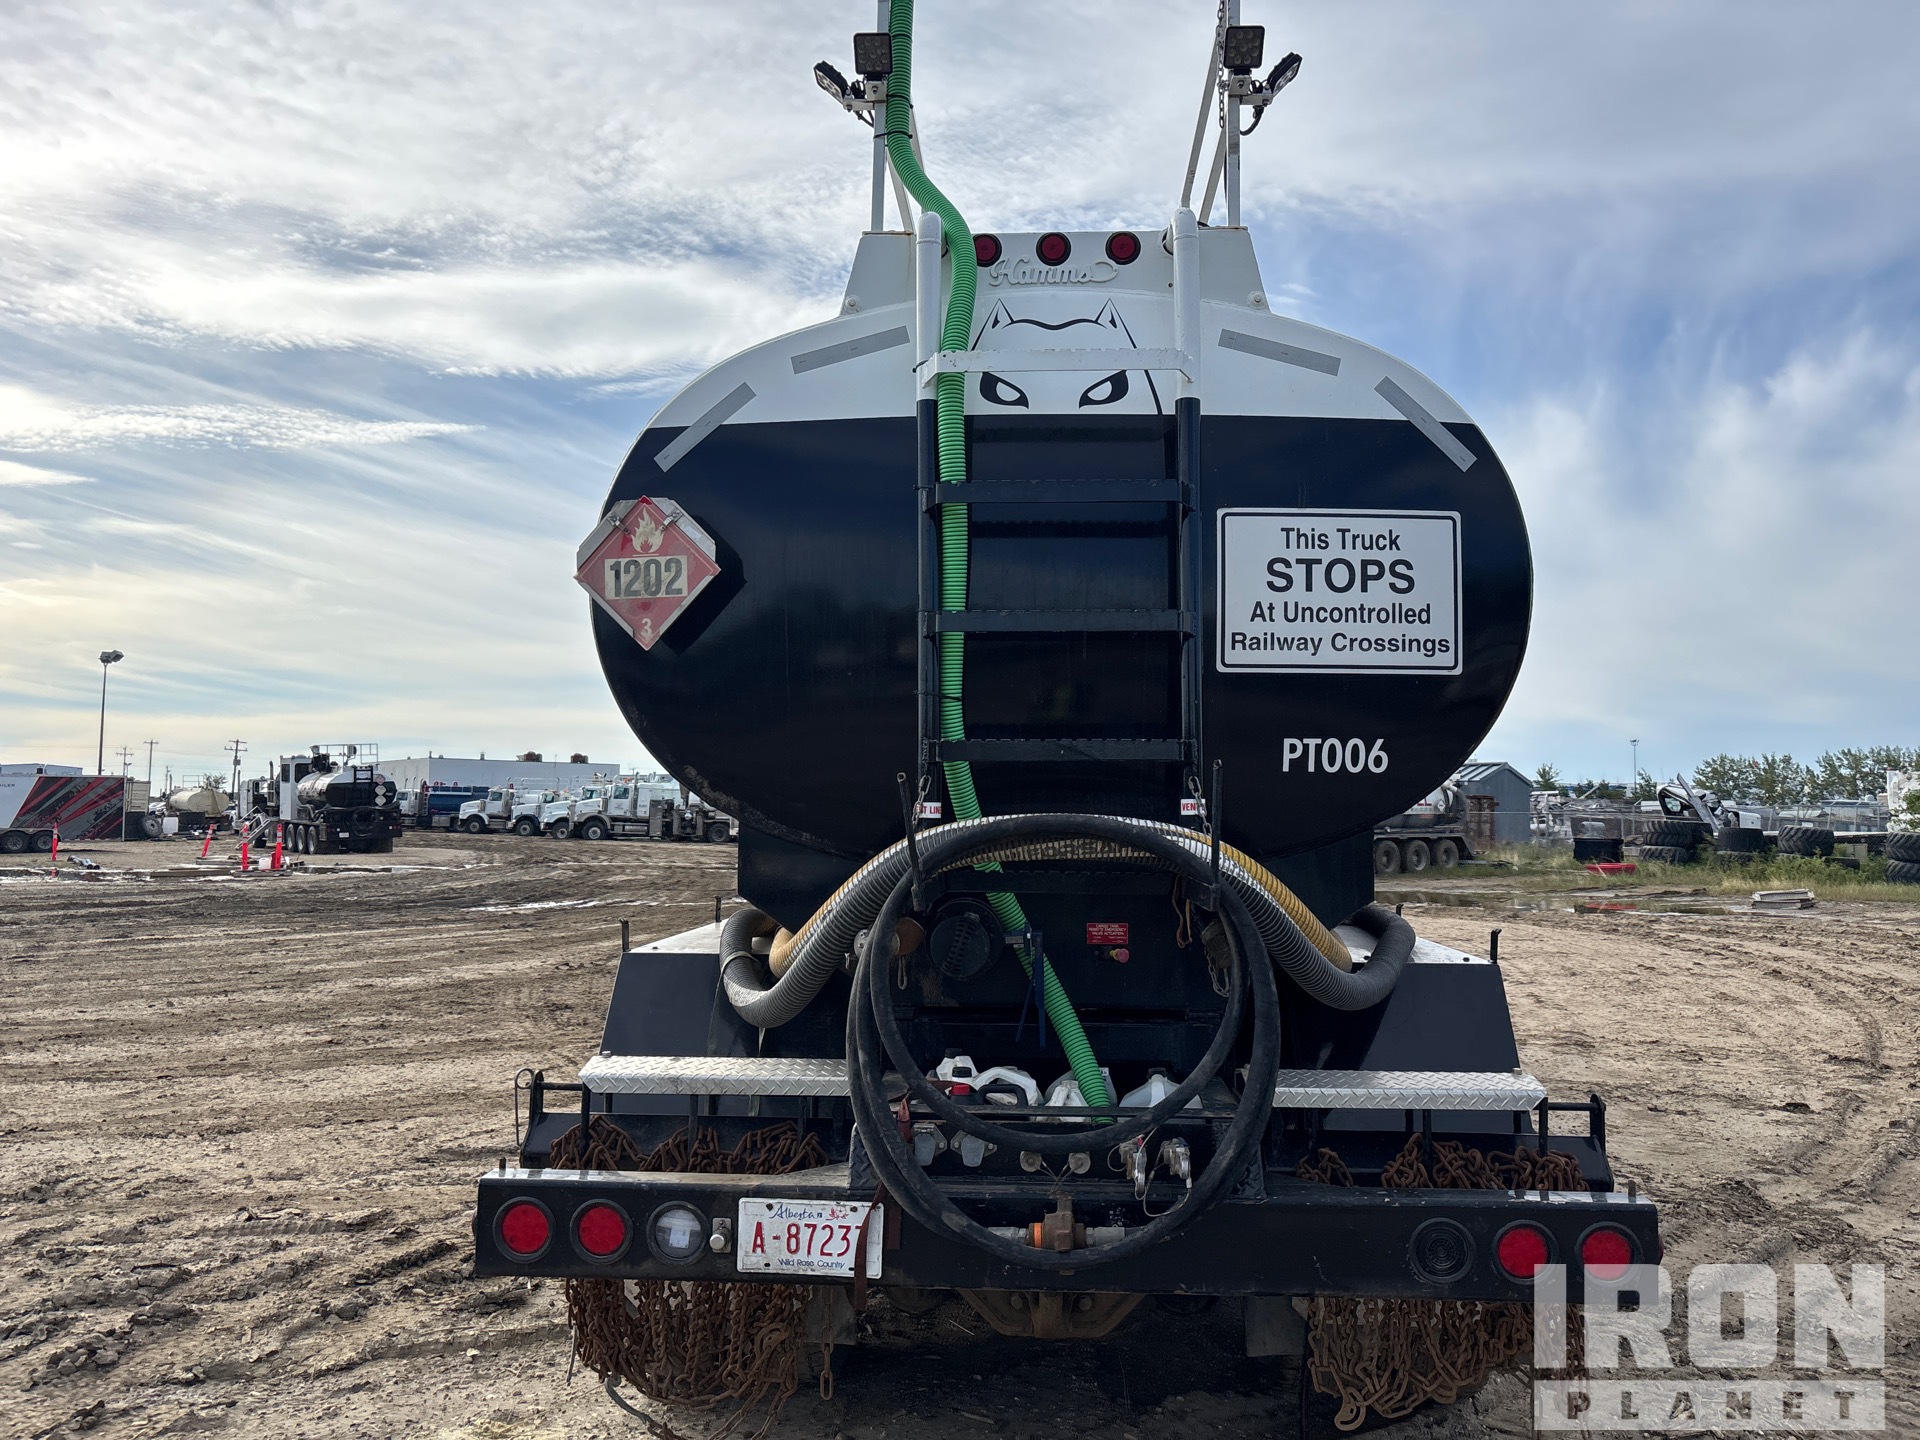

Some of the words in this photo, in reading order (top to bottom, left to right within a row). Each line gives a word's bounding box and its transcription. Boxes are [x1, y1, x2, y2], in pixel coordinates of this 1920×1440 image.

[1280, 527, 1330, 550] This
[1336, 528, 1401, 551] Truck
[609, 557, 683, 597] 1202
[1266, 557, 1415, 594] STOPS
[1249, 601, 1276, 623] At
[1283, 601, 1431, 624] Uncontrolled
[641, 617, 653, 639] 3
[1231, 631, 1323, 656] Railway
[1330, 632, 1451, 658] Crossings
[1282, 737, 1389, 774] PT006
[769, 1203, 817, 1220] Alberta
[777, 1258, 794, 1267] Wild
[797, 1259, 815, 1267] Rose
[817, 1259, 845, 1269] Country
